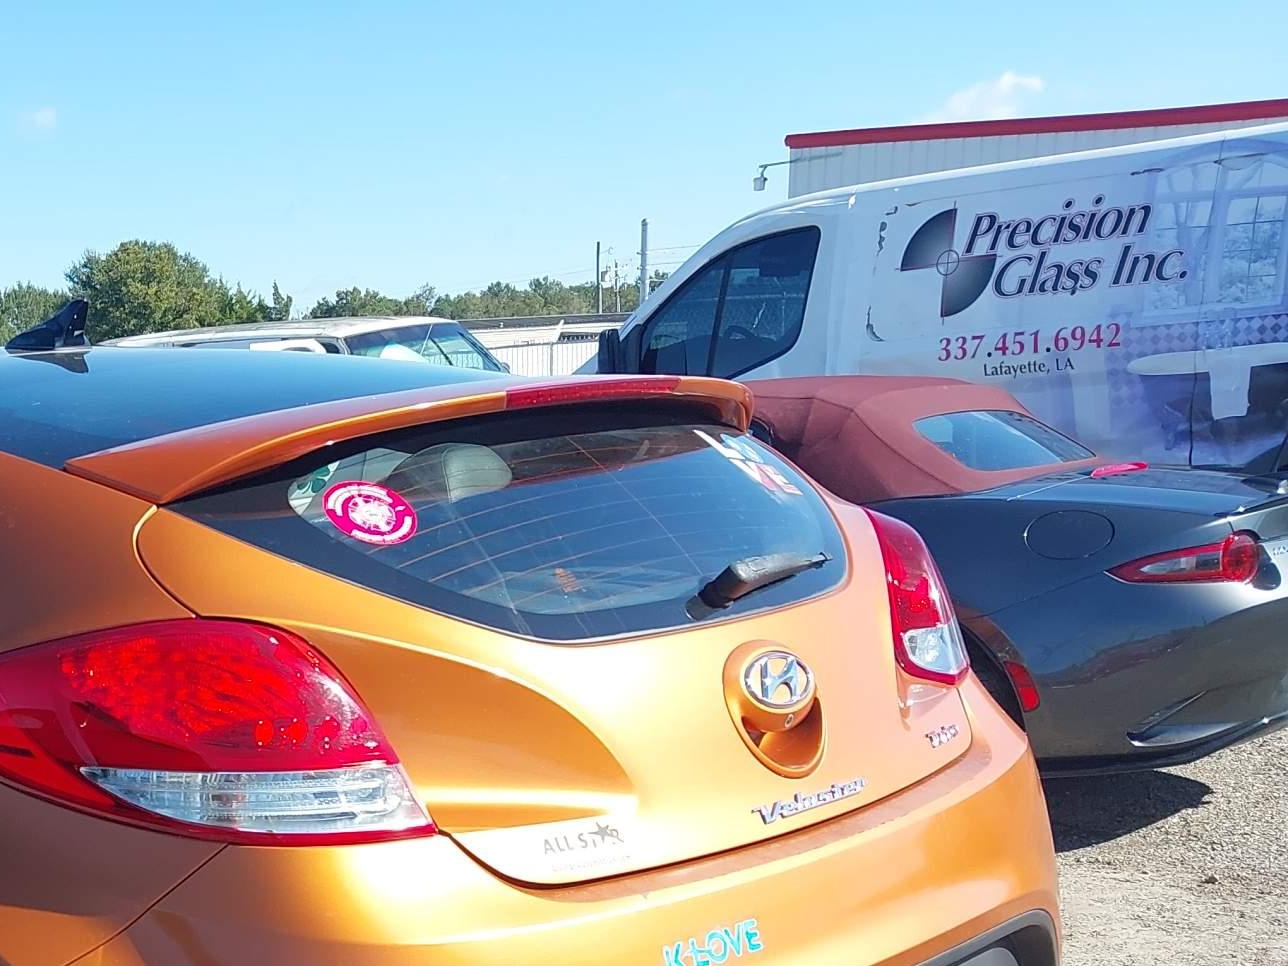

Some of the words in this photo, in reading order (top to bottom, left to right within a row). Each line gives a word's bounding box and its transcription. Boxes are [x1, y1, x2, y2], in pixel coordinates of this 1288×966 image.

[962, 194, 1153, 256] Precision
[993, 249, 1105, 298] Glass
[1109, 243, 1189, 288] Inc.
[938, 323, 1121, 362] 337.451.6942
[983, 360, 1050, 379] Lafayette,
[1055, 357, 1074, 371] LA
[751, 778, 867, 824] Veloster
[544, 835, 575, 855] ALL
